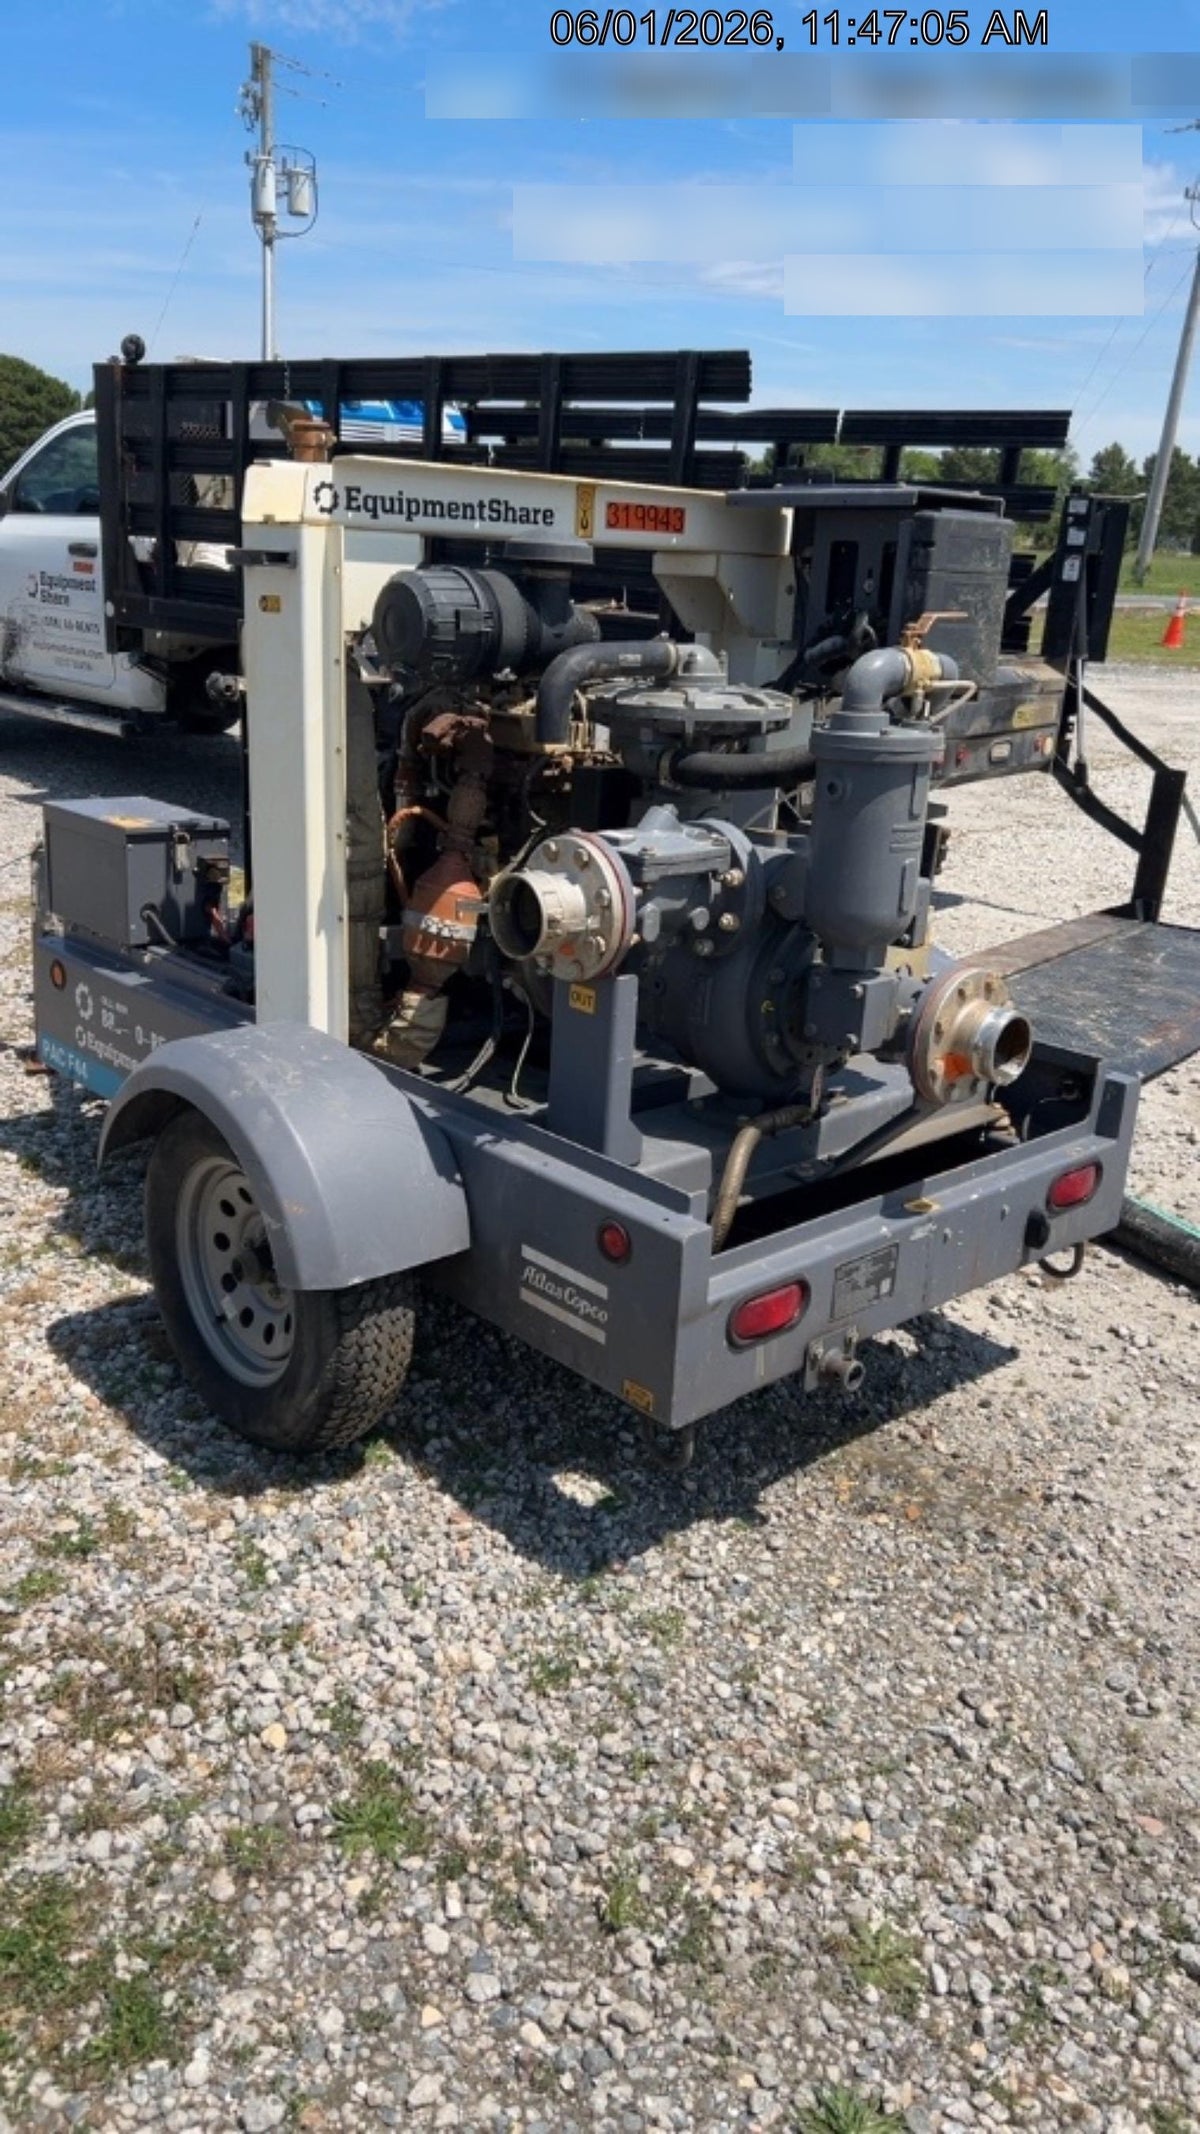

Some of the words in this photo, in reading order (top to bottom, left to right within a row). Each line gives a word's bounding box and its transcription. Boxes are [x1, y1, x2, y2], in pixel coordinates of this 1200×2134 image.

[344, 485, 555, 527] EquipmentShare
[607, 502, 686, 533] 319943
[40, 571, 96, 593] Equipment
[40, 589, 70, 607] Share
[571, 990, 593, 1009] OUT
